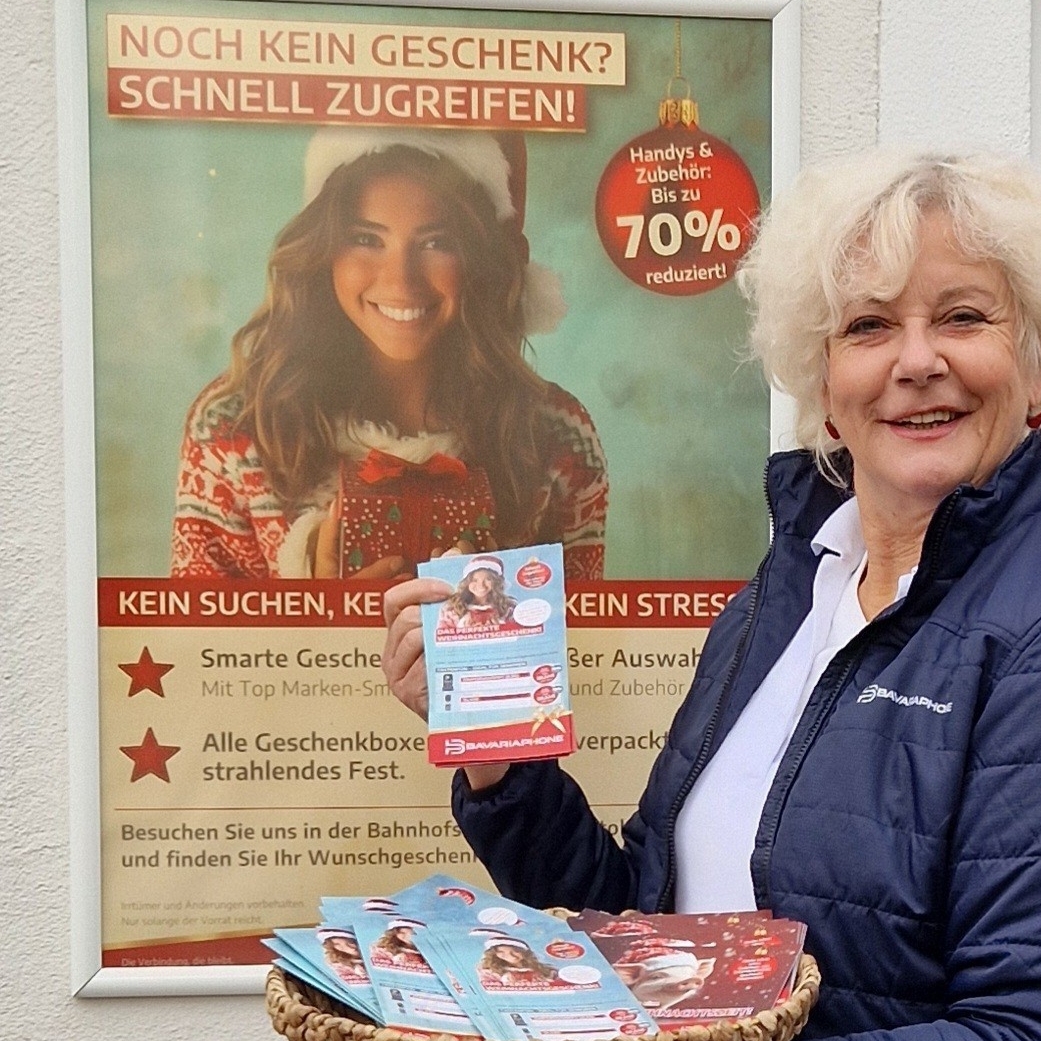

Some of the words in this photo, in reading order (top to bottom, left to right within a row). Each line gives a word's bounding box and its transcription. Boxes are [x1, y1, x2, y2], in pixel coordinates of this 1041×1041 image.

[120, 25, 242, 61] NOCH
[260, 30, 355, 65] KEIN
[371, 34, 612, 73] GESCHENK?
[119, 75, 314, 115] SCHNELL
[326, 82, 575, 123] ZUGREIFEN!
[630, 143, 695, 163] Handys
[700, 142, 714, 158] &
[635, 164, 711, 184] Zubehör:
[651, 188, 677, 204] Bis
[681, 188, 701, 202] zu
[616, 208, 741, 259] 70%
[646, 263, 727, 284] reduziert!
[119, 591, 190, 616] KEIN
[200, 591, 334, 621] SUCHEN,
[201, 649, 288, 668] Smarte
[201, 681, 234, 697] Mit
[240, 681, 276, 700] Top
[570, 679, 603, 696] und
[609, 678, 685, 696] Zubehör
[202, 732, 247, 752] Alle
[465, 734, 564, 751] BAVARIAPHONE
[202, 760, 341, 781] strahlendes
[349, 761, 405, 780] Fest.
[121, 823, 218, 841] Besuchen
[225, 823, 255, 840] Sie
[261, 824, 297, 840] uns
[303, 822, 321, 839] in
[328, 822, 361, 839] der
[122, 850, 160, 867] und
[166, 850, 231, 867] finden
[239, 850, 268, 866] Sie
[275, 850, 302, 866] Ihr
[308, 848, 477, 869] Wunschgeschen
[164, 901, 182, 910] und
[121, 918, 139, 926] Nur
[142, 917, 179, 927] solange
[183, 916, 198, 925] der
